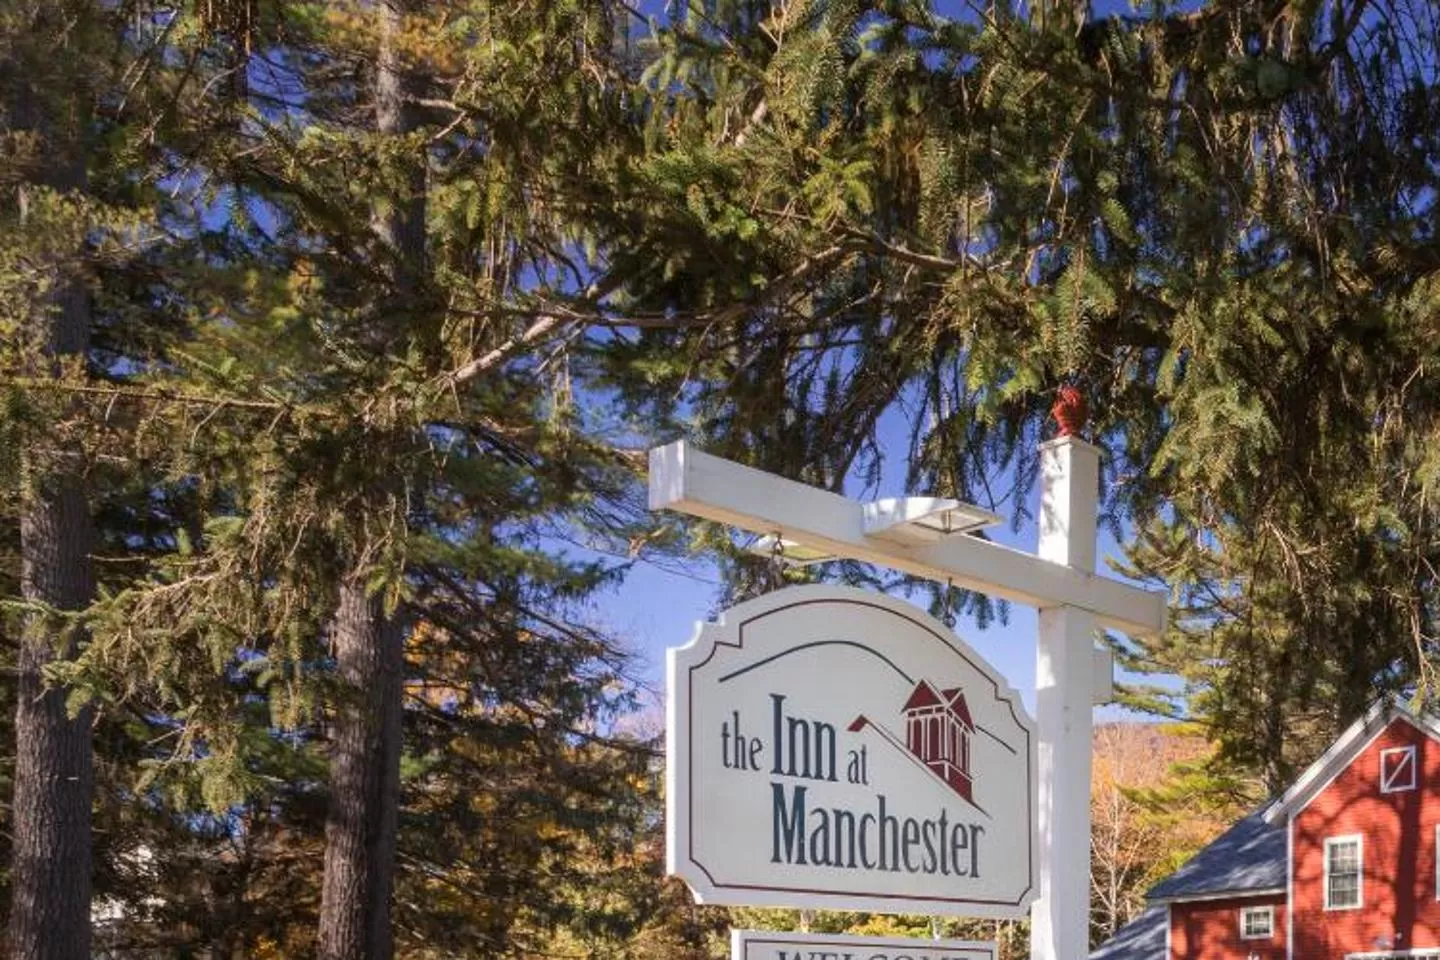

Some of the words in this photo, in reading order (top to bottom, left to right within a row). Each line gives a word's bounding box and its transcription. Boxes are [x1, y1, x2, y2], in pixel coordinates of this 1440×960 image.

[721, 710, 763, 771] the
[769, 693, 839, 782] Inn
[847, 744, 869, 785] at
[770, 782, 986, 878] Manchester
